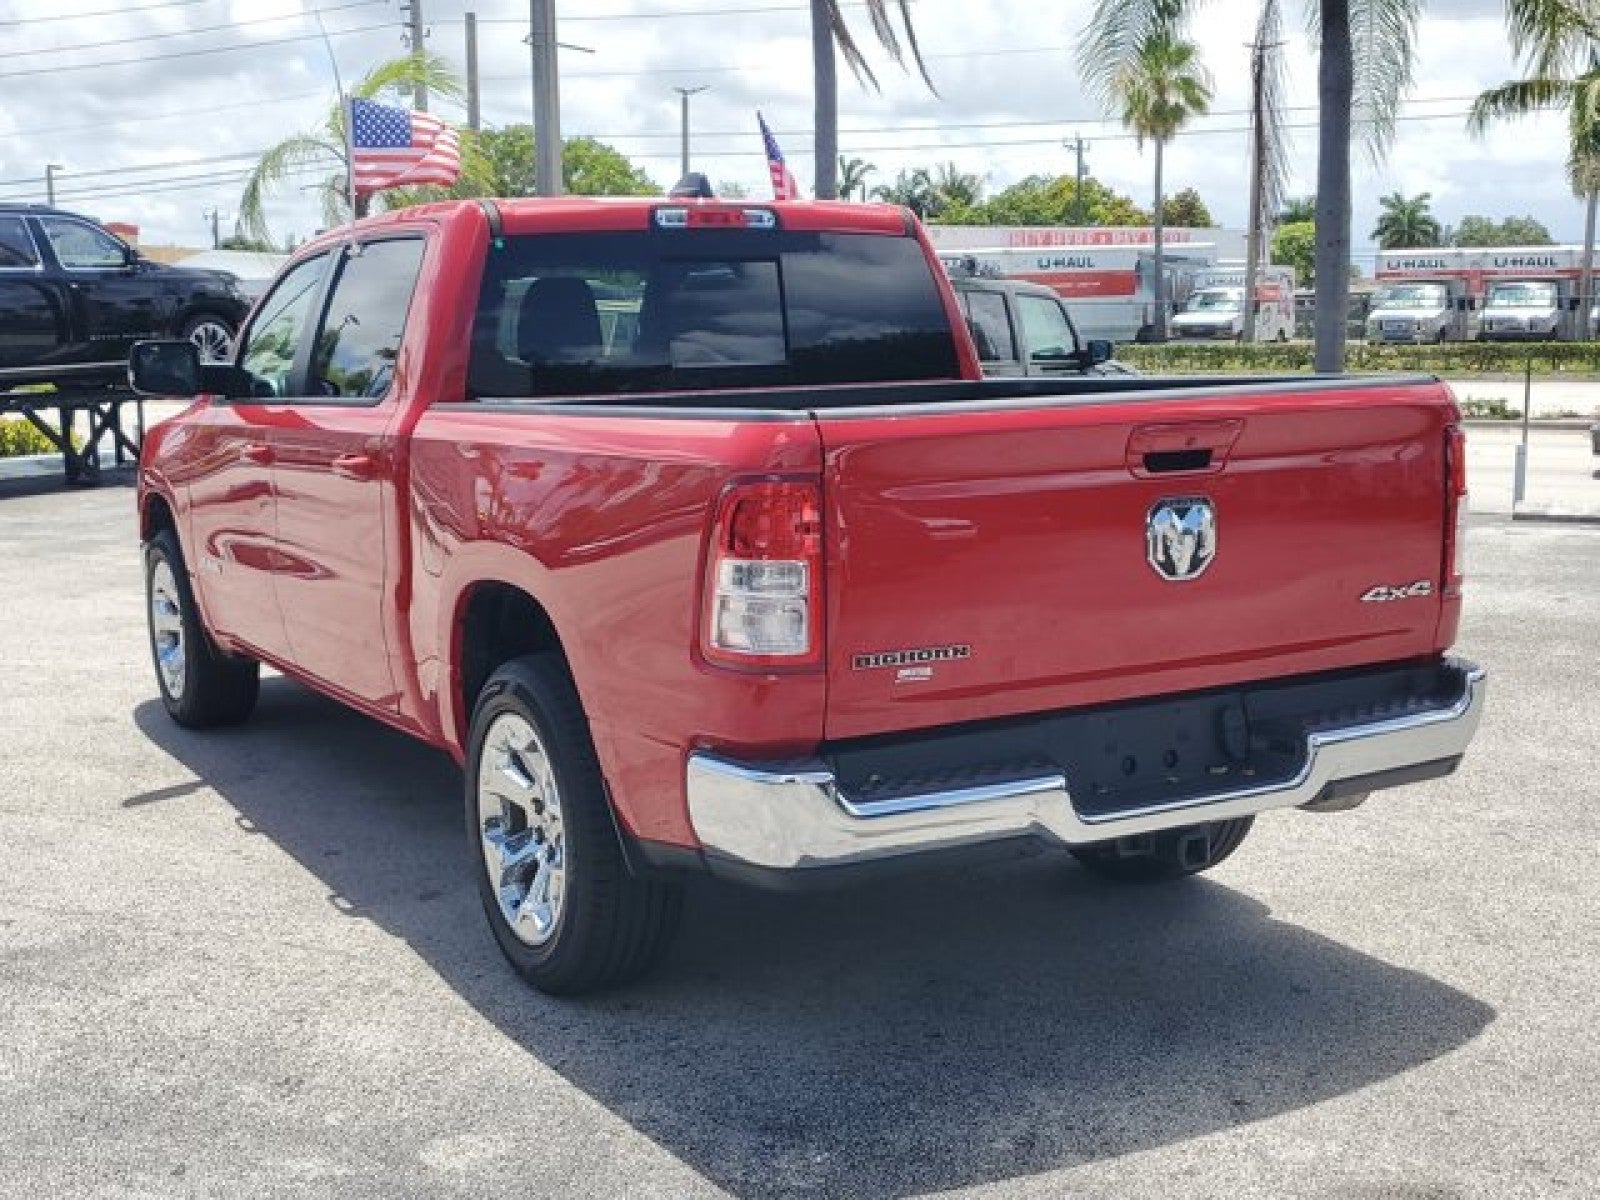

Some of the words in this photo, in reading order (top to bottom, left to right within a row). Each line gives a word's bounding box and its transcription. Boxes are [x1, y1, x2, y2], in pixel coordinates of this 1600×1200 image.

[1037, 256, 1096, 268] U-HAUL
[1387, 259, 1449, 270] U-HAUL
[1494, 256, 1558, 268] U-HAUL
